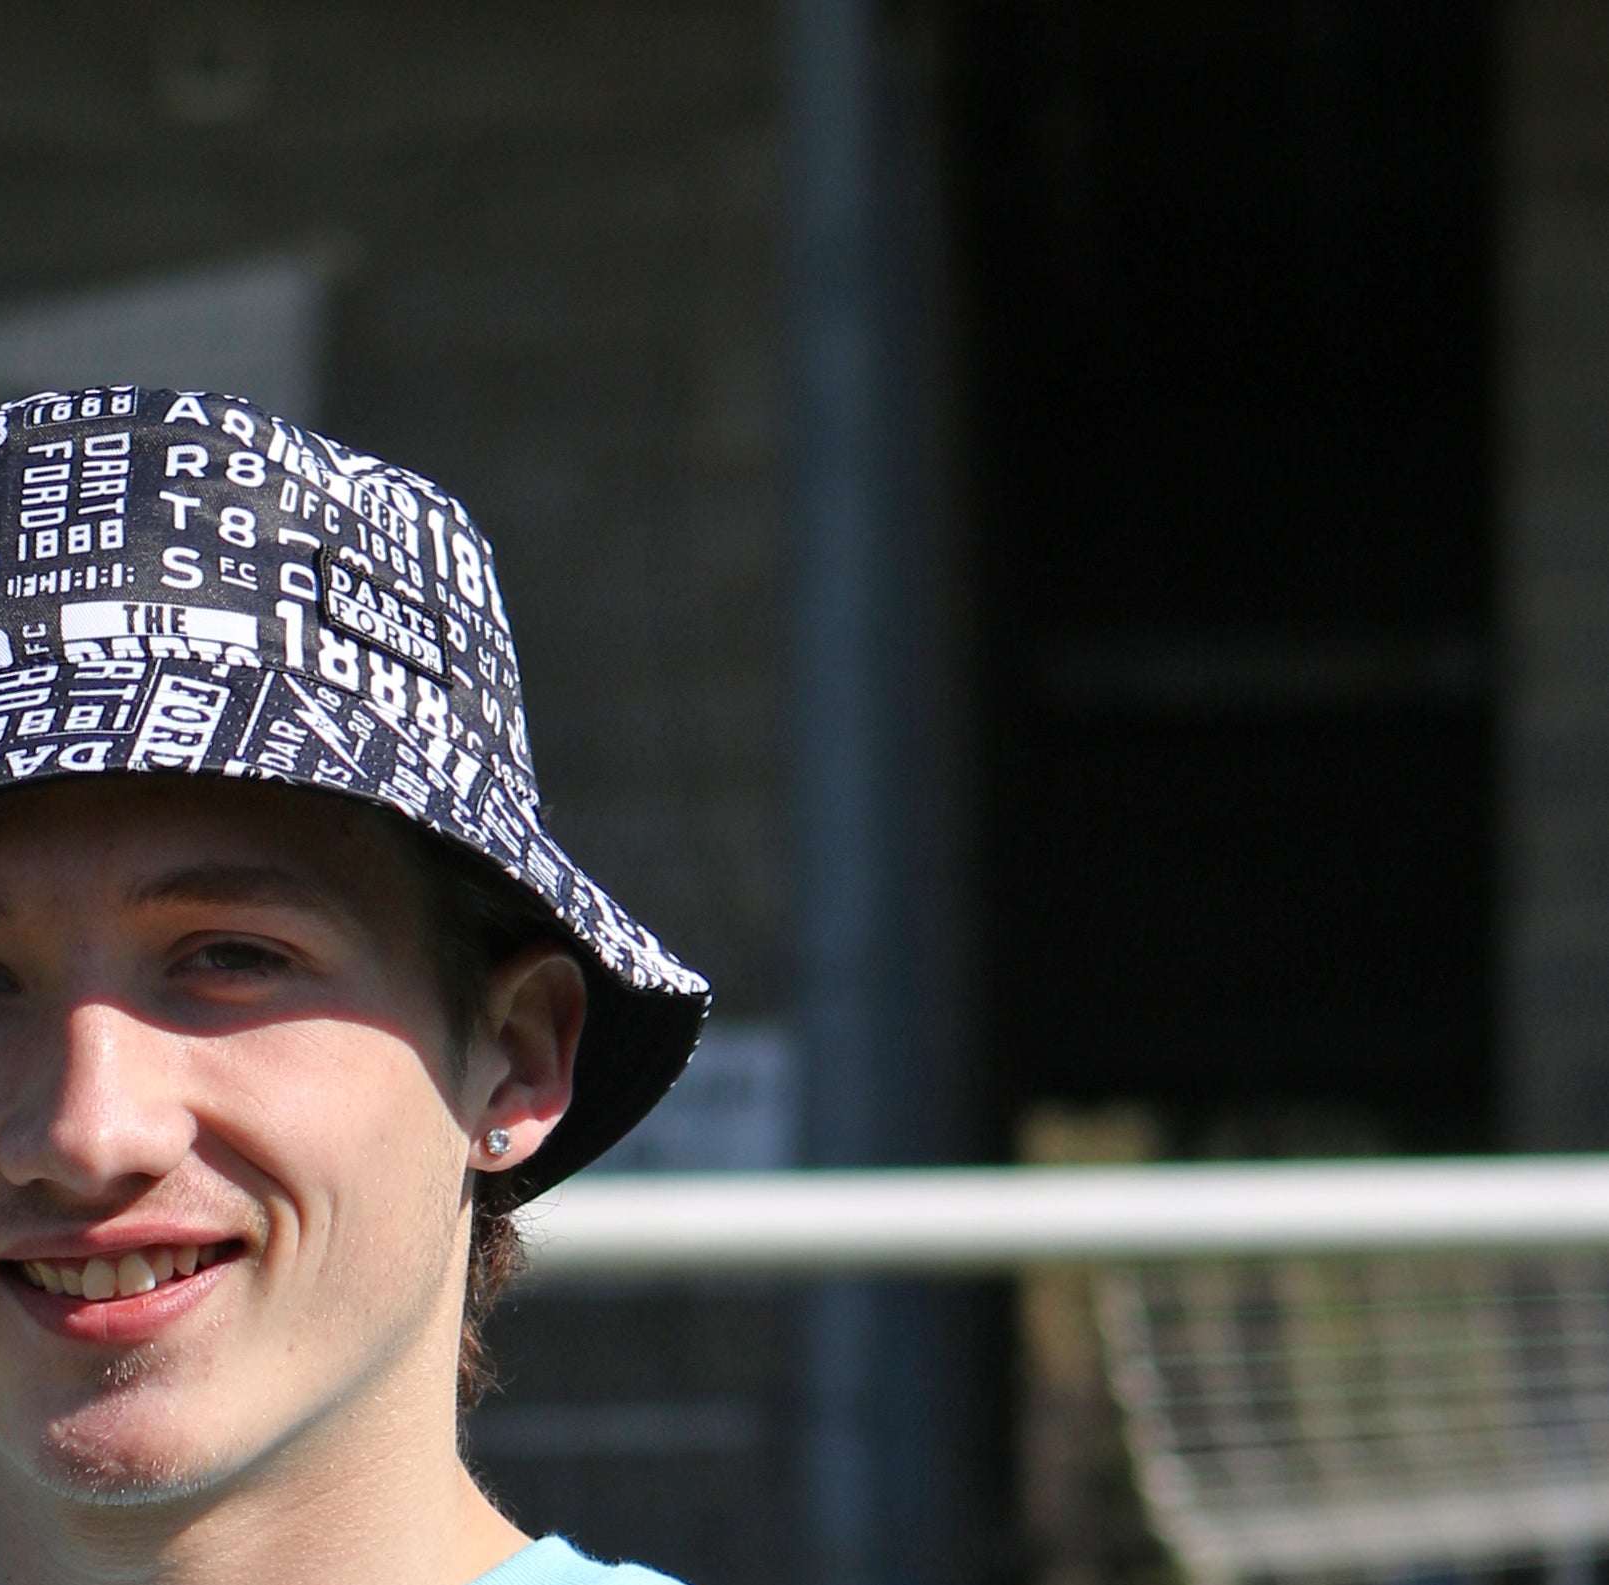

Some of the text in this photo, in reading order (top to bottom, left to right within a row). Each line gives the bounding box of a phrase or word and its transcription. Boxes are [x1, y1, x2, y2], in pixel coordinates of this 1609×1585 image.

[279, 479, 340, 534] DFC
[17, 518, 124, 562] 1888
[356, 523, 424, 589] 1888
[220, 556, 258, 582] FC
[123, 604, 187, 635] THE
